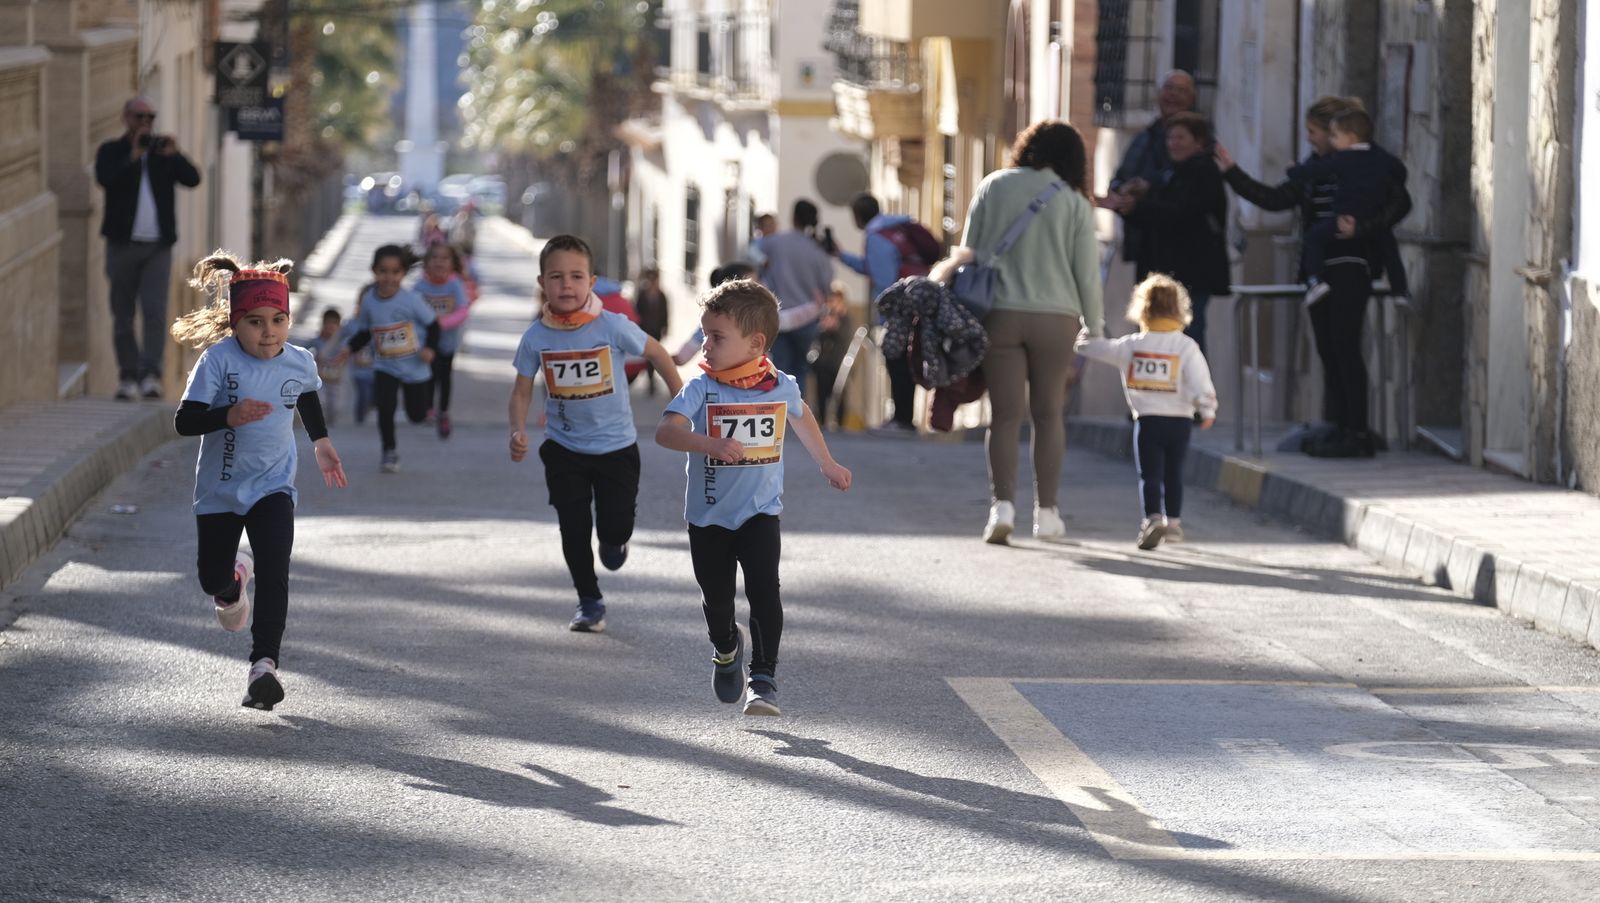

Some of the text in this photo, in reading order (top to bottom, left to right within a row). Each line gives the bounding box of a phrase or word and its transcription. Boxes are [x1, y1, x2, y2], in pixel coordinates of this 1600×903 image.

[553, 361, 600, 379] 712
[1135, 359, 1168, 375] 701
[227, 372, 239, 391] LA
[722, 417, 775, 438] 713
